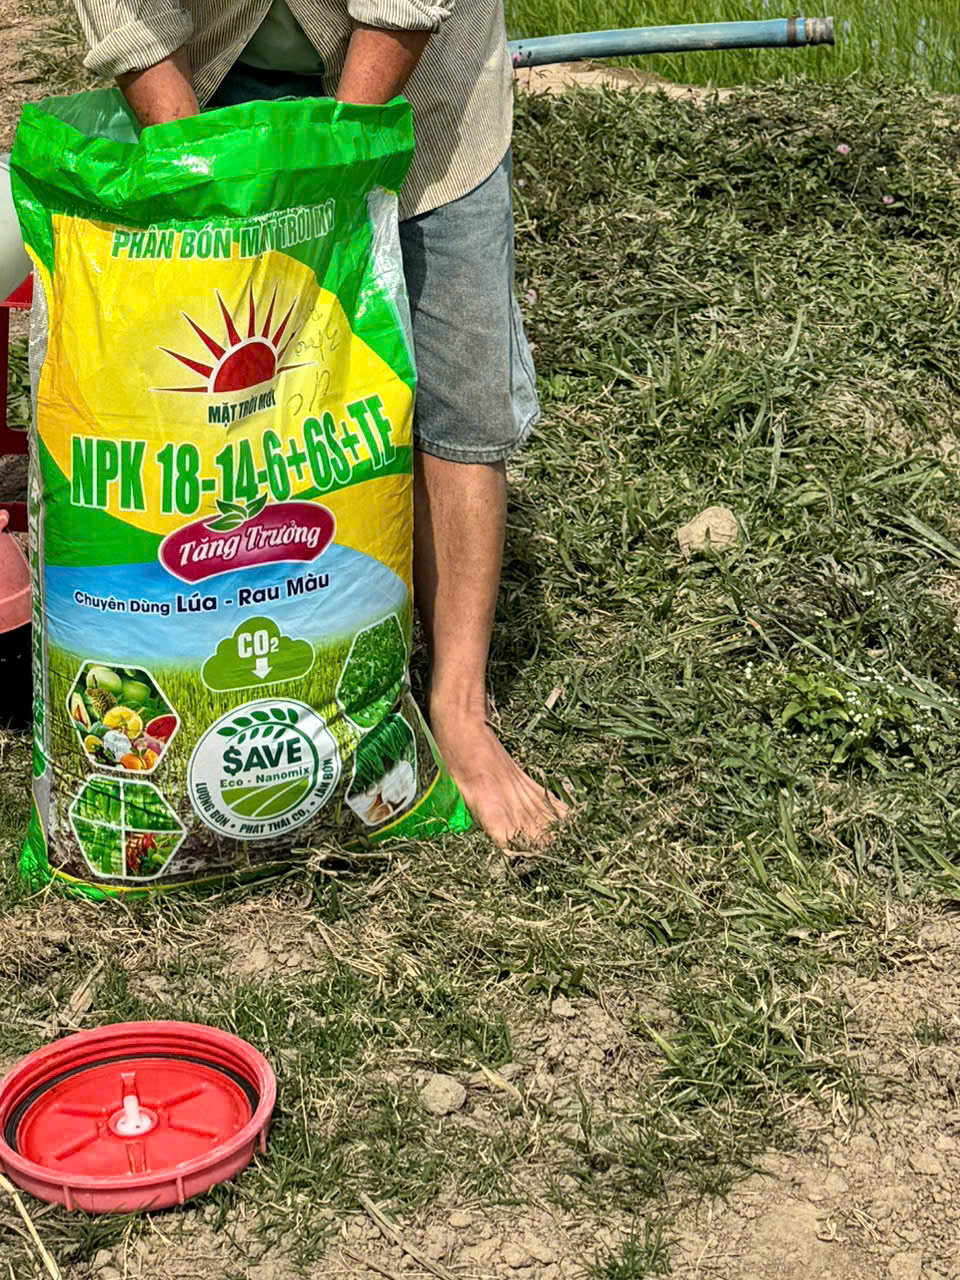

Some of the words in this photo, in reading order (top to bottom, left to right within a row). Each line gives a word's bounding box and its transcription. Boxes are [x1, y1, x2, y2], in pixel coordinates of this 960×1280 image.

[111, 223, 177, 261] PHÂN
[179, 221, 233, 261] BÓN
[208, 402, 238, 427] MẶT
[238, 395, 258, 419] TRỜI
[70, 434, 148, 513] NPK
[155, 393, 397, 516] 18-14-6+6S+TE
[178, 533, 244, 567] Tăng
[244, 520, 322, 552] Trưởng
[73, 590, 126, 613] Chuyên
[129, 598, 171, 616] Dùng
[176, 592, 219, 614] Lúa
[238, 587, 281, 607] Rau
[286, 572, 331, 598] Màu
[222, 736, 303, 777] $AVE
[220, 778, 244, 789] Eco
[256, 766, 310, 784] Nanomix
